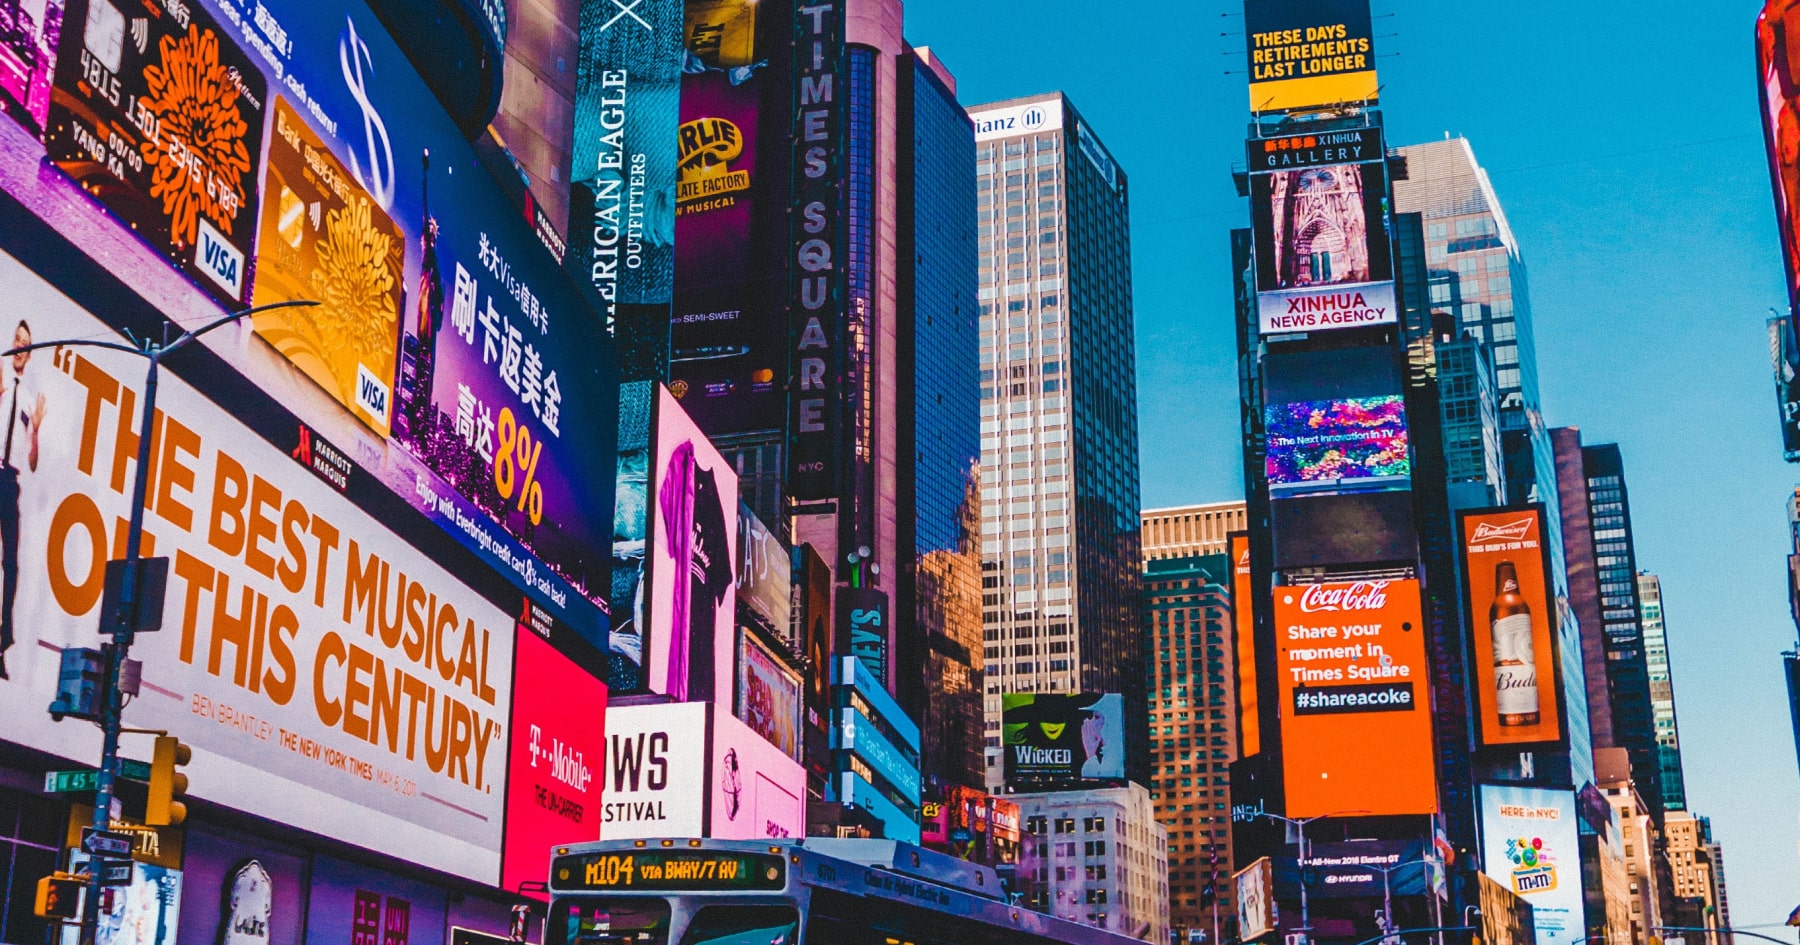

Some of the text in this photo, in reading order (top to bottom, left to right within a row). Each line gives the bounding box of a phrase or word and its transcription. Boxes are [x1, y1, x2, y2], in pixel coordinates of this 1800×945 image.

[1253, 23, 1347, 48] THESE DAYS
[1253, 37, 1369, 64] RETIREMENTS
[80, 48, 121, 107] 4815
[241, 20, 283, 79] spending
[306, 94, 337, 138] return!
[1253, 53, 1366, 80] LAST LONGER
[598, 69, 627, 171] EAGLE
[72, 121, 125, 182] YANG KA
[1318, 132, 1362, 146] XINHUA
[1267, 146, 1362, 166] GALLERY
[703, 173, 745, 193] FACTORY
[626, 153, 646, 269] OUTFITTERS
[686, 196, 735, 214] MUSICAL
[797, 4, 833, 433] TIMES SQUARE
[203, 231, 237, 287] VISA
[478, 231, 549, 336] 光大Visa信用卡
[1287, 292, 1367, 314] XINHUA
[683, 311, 740, 323] SEMI-SWEET
[1270, 307, 1386, 329] NEWS AGENCY
[451, 260, 562, 438] 刷卡返美金
[360, 372, 385, 416] VISA
[1278, 428, 1394, 447] The Next Innovation in TV
[315, 438, 352, 472] MARRIOTT
[799, 462, 825, 473] NYC
[313, 460, 347, 489] MARQUIS
[416, 475, 438, 512] Enjoy
[438, 497, 456, 523] with
[455, 507, 492, 550] Everbright
[492, 540, 512, 567] credit
[537, 573, 551, 597] cash
[550, 587, 567, 610] back!
[208, 449, 340, 609] BEST
[342, 538, 497, 706] MUSICAL
[1300, 580, 1389, 613] Coca-Cola
[174, 548, 299, 706] THIS
[1288, 623, 1382, 640] Share your
[1289, 642, 1384, 662] moment in
[1290, 663, 1410, 683] Times Square
[1296, 688, 1411, 709] #shareacoke
[191, 693, 215, 719] BEN
[217, 703, 275, 739] BRANTLEY
[279, 728, 297, 751] THE
[299, 738, 323, 762] NEW
[323, 747, 348, 771] YORK
[348, 755, 373, 782] TIMES
[376, 767, 393, 786] MAY
[601, 731, 669, 795] WS
[57, 774, 68, 789] W
[71, 772, 86, 789] 45
[535, 784, 547, 808] THE
[600, 800, 667, 823] STIVAL
[1500, 806, 1526, 817] HERE
[1536, 810, 1559, 820] NYC!
[766, 819, 779, 839] SHOP
[585, 855, 634, 885] M104
[641, 865, 662, 879] VIA
[718, 861, 738, 880] AV
[1312, 857, 1341, 867] All-New
[1387, 854, 1400, 863] GT
[1338, 874, 1373, 883] HYUNDAI
